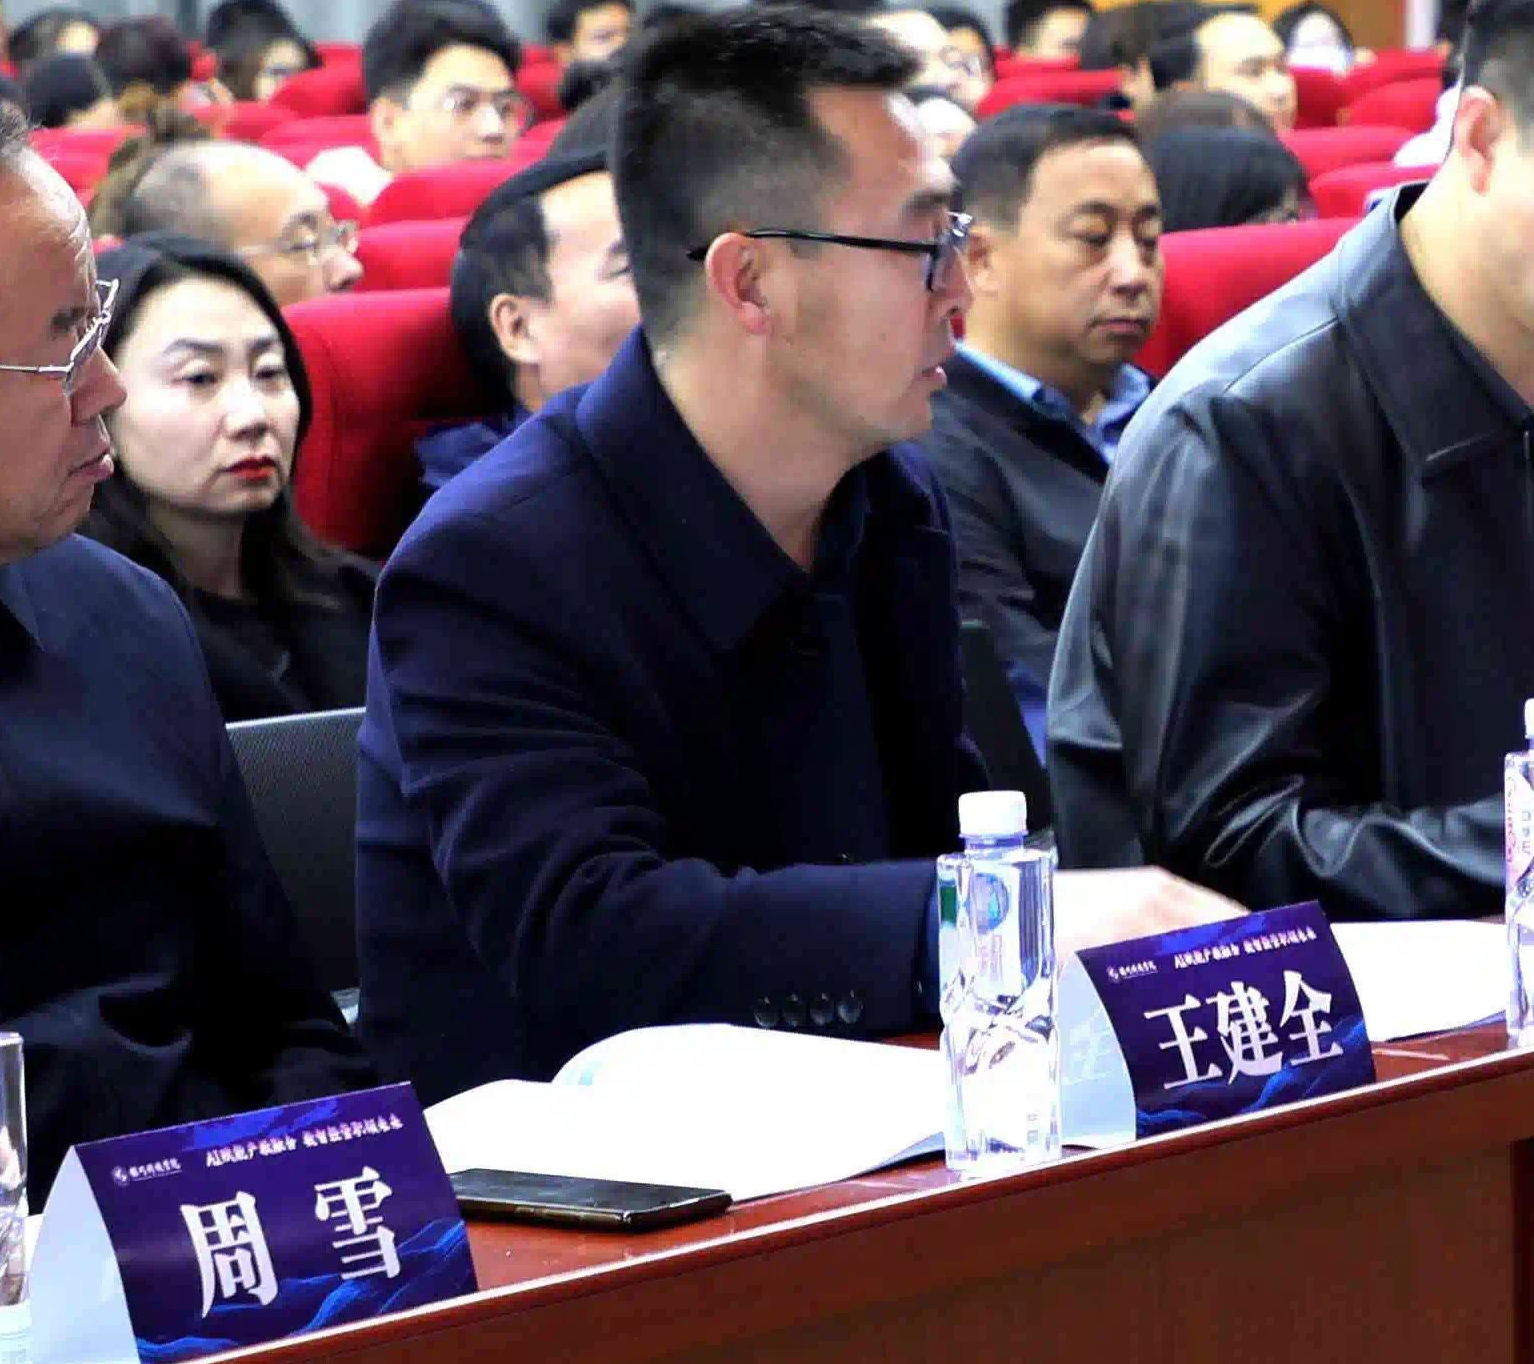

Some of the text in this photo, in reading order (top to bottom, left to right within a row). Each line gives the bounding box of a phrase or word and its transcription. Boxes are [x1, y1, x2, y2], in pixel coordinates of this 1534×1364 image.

[1143, 969, 1344, 1091] 王建全
[180, 1165, 402, 1319] 周雪
